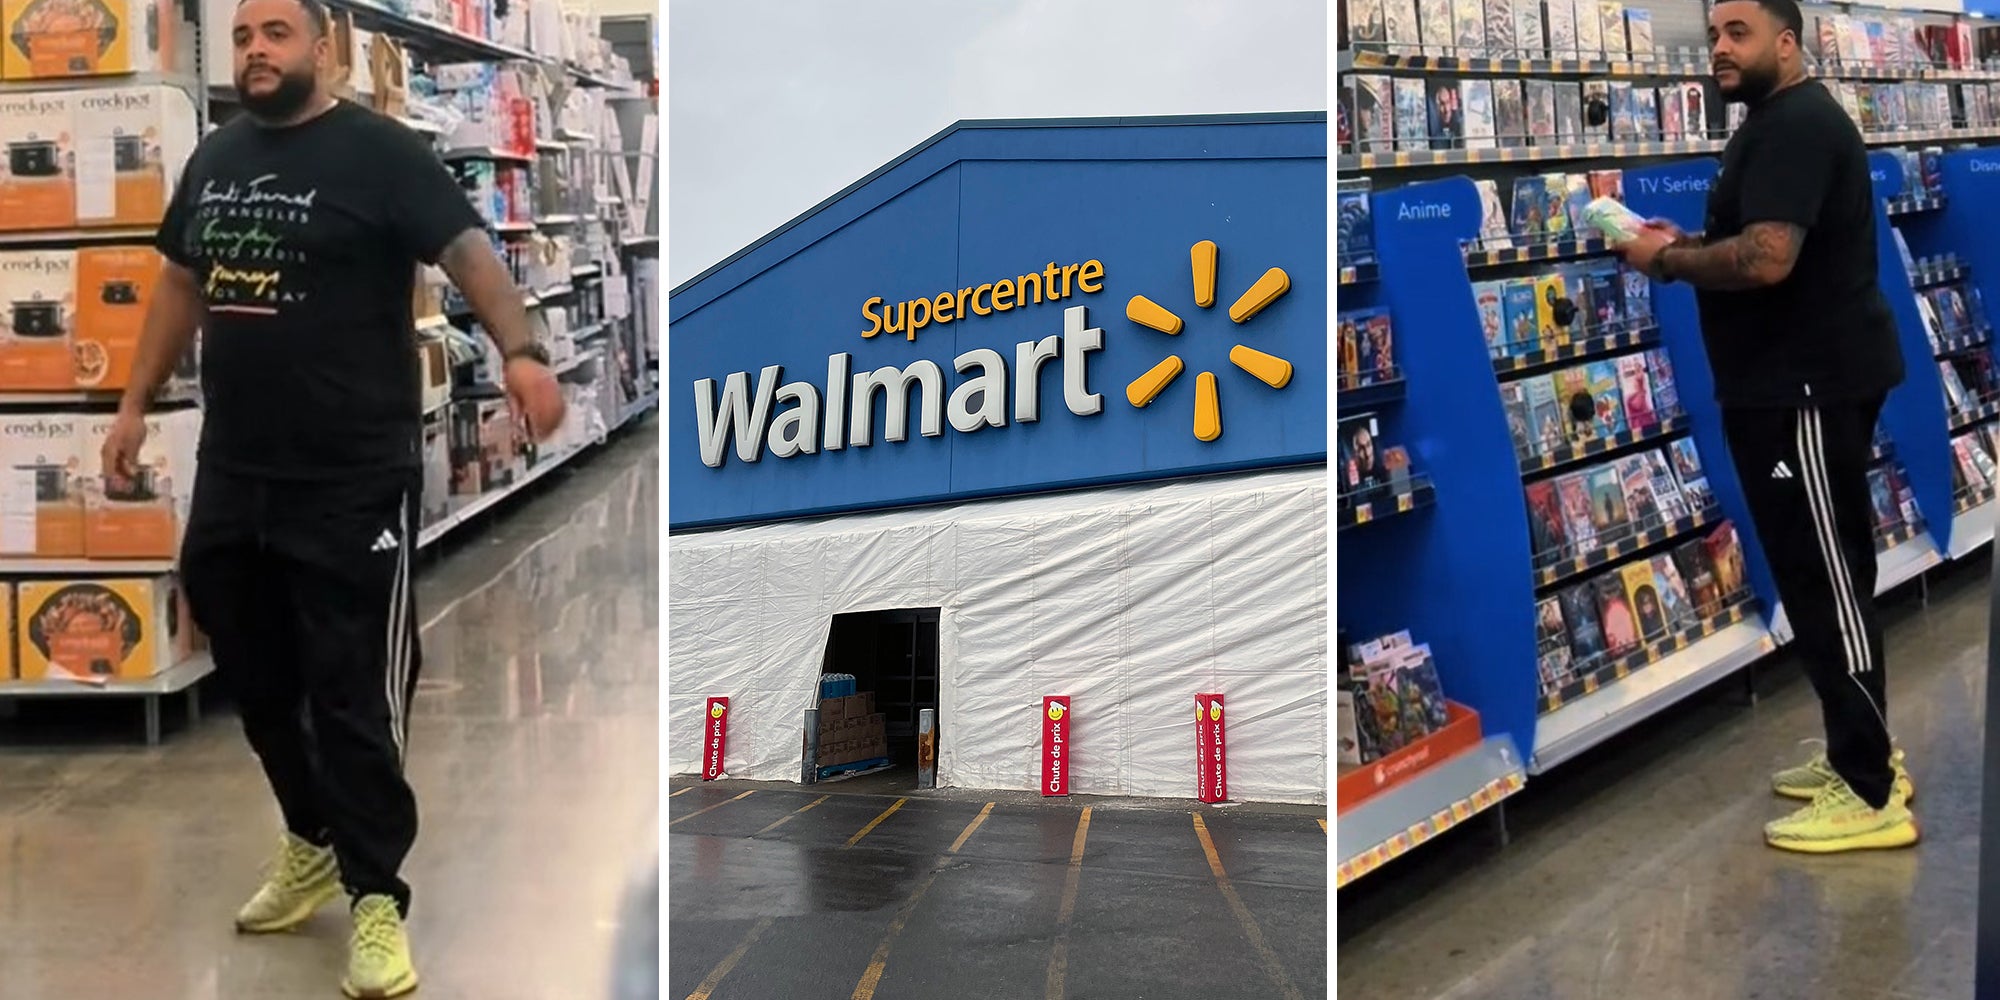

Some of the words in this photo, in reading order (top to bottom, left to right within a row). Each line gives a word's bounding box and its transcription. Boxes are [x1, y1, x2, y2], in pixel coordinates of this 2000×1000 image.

[1969, 158, 2000, 173] Disn
[1637, 176, 1659, 195] TV
[1662, 174, 1710, 193] Series
[227, 206, 309, 224] ANGELES
[1397, 199, 1452, 221] Anime
[860, 258, 1106, 342] Supercentre
[692, 304, 1106, 469] Walmart
[712, 720, 722, 737] prix
[1050, 722, 1064, 743] prix
[1213, 723, 1222, 745] prix
[711, 737, 720, 749] de
[1050, 744, 1061, 758] de
[709, 750, 719, 777] Chute
[1199, 747, 1205, 762] de
[1213, 747, 1222, 761] de
[1049, 760, 1061, 793] Chute
[1215, 763, 1223, 798] Chute
